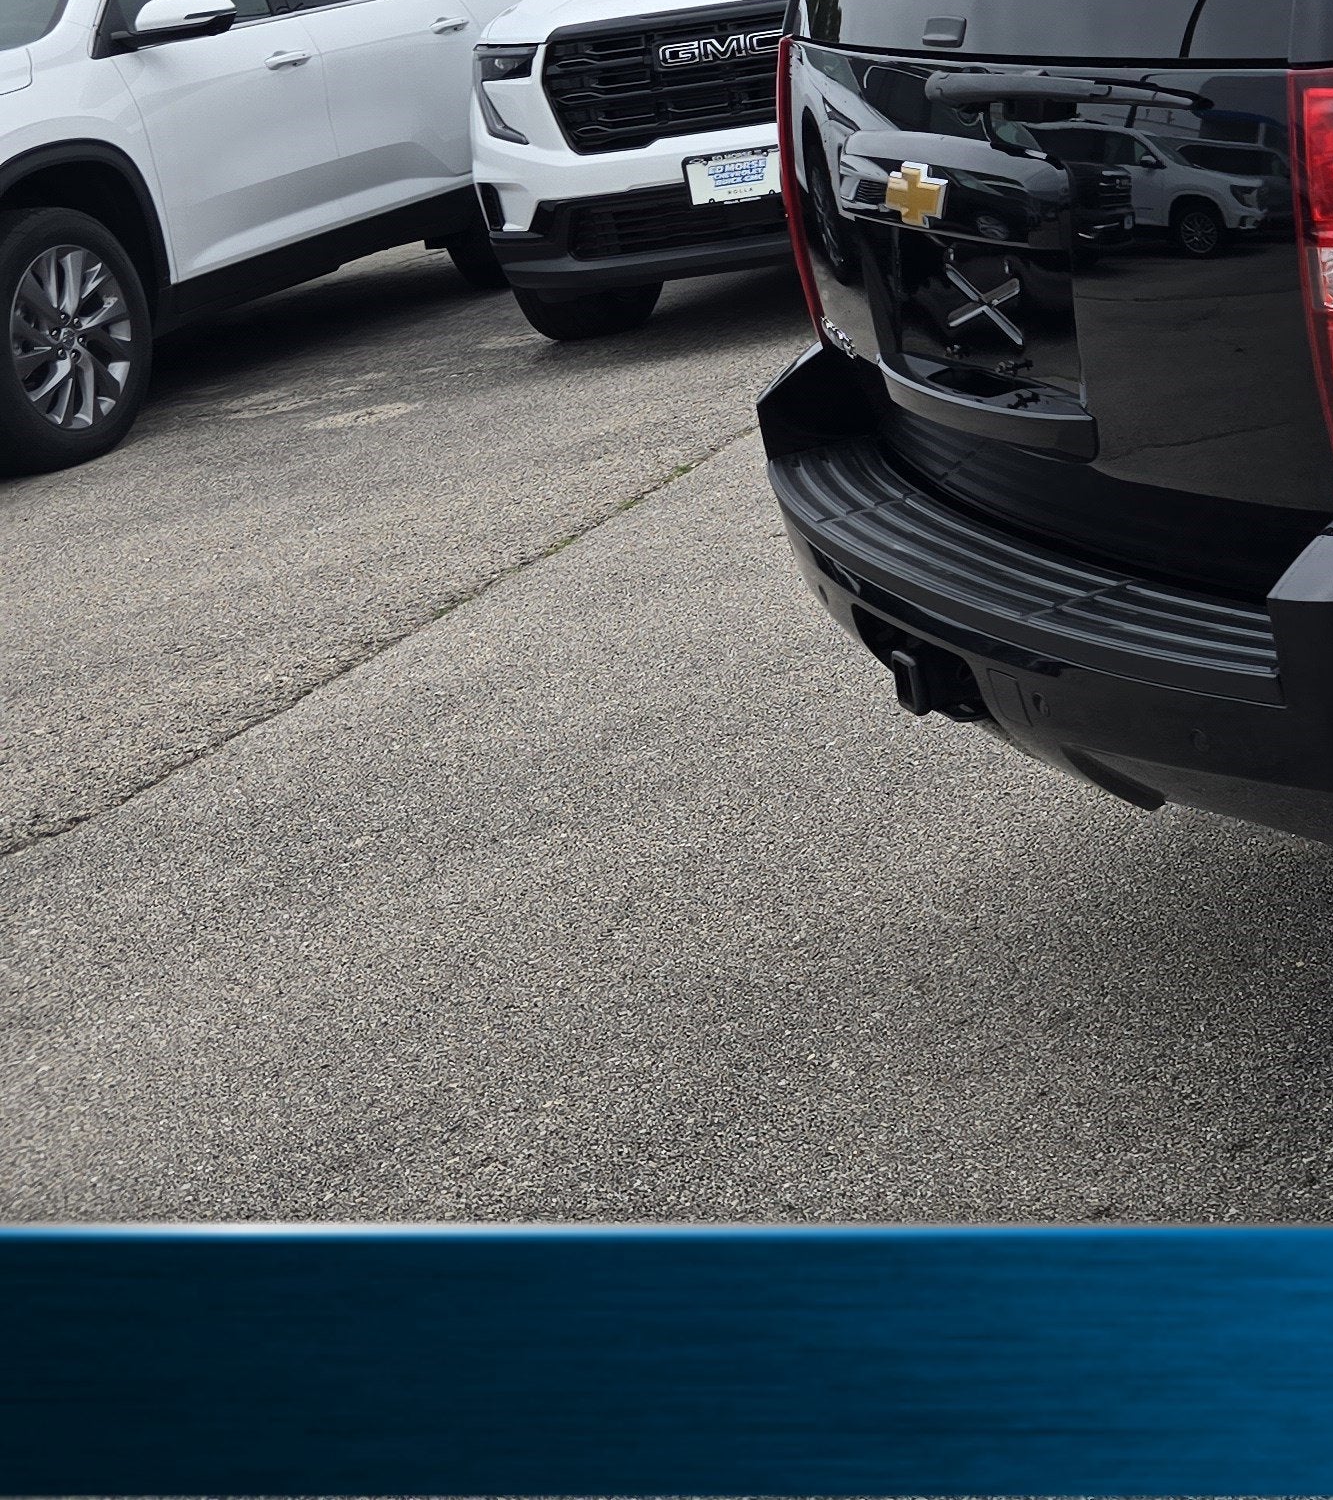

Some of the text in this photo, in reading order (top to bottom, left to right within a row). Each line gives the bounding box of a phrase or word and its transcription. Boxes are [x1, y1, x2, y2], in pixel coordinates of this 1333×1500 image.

[658, 28, 784, 67] GMC
[708, 158, 767, 176] ED MORSE
